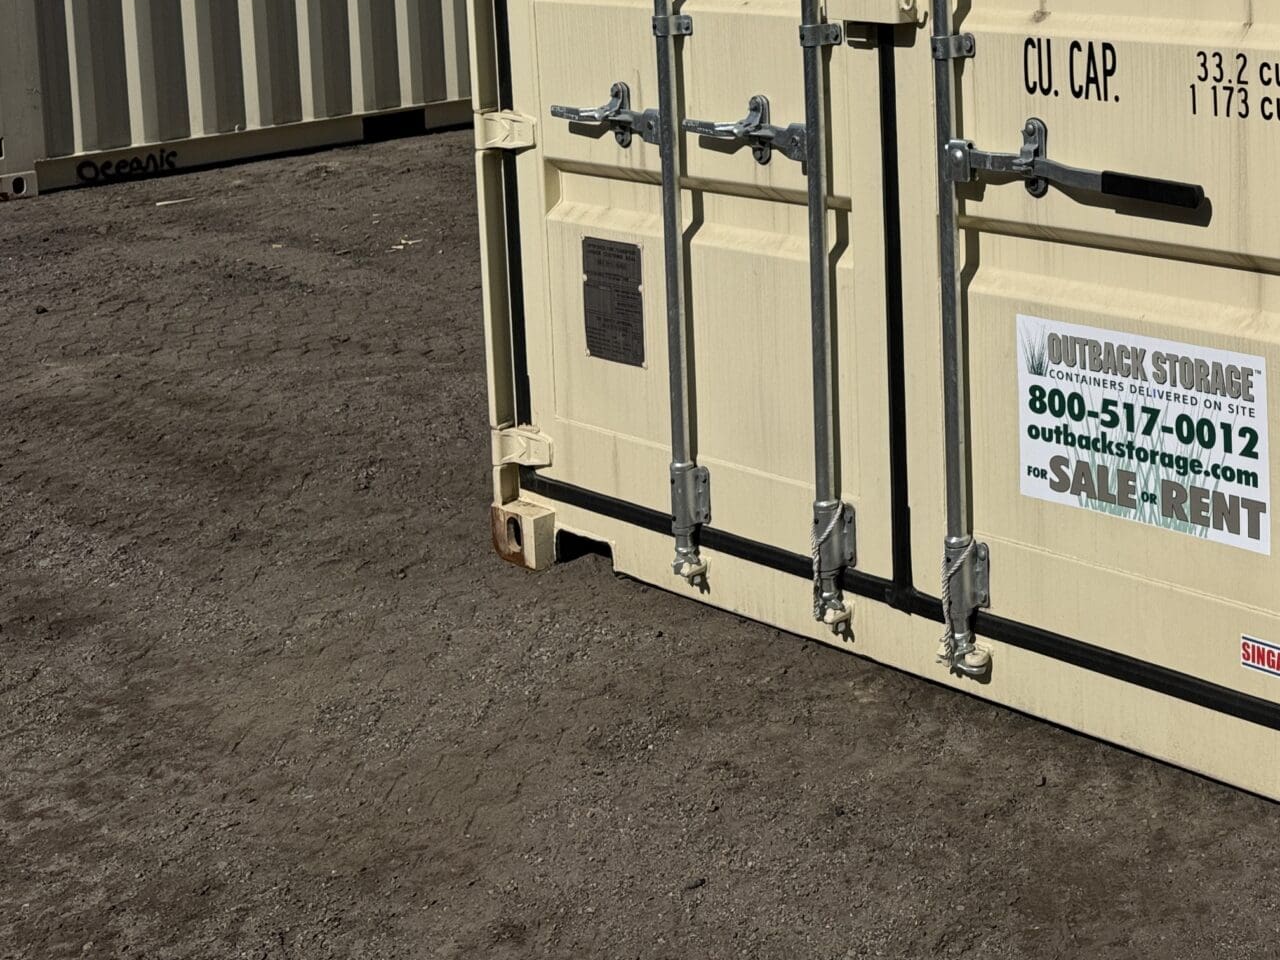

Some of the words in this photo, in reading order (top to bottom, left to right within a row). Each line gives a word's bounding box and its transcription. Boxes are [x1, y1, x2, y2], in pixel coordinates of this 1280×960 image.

[1024, 38, 1059, 97] CU.
[1070, 41, 1120, 103] CAP.
[1197, 51, 1248, 85] 33.2
[1190, 84, 1197, 115] 1
[1212, 86, 1249, 119] 173
[1047, 332, 1148, 382] OUTBACK
[1151, 350, 1255, 403] STORAGE
[1049, 369, 1124, 392] CONTAINERS
[1130, 384, 1198, 406] DELIVERED
[1203, 399, 1222, 411] ON
[1228, 403, 1256, 418] SITE
[1028, 384, 1259, 460] 800-517-0012
[1027, 423, 1259, 488] outbackstorage.com
[1027, 465, 1048, 480] FOR
[1049, 455, 1137, 510] SALE
[1141, 491, 1157, 505] OR
[1161, 478, 1267, 541] RENT
